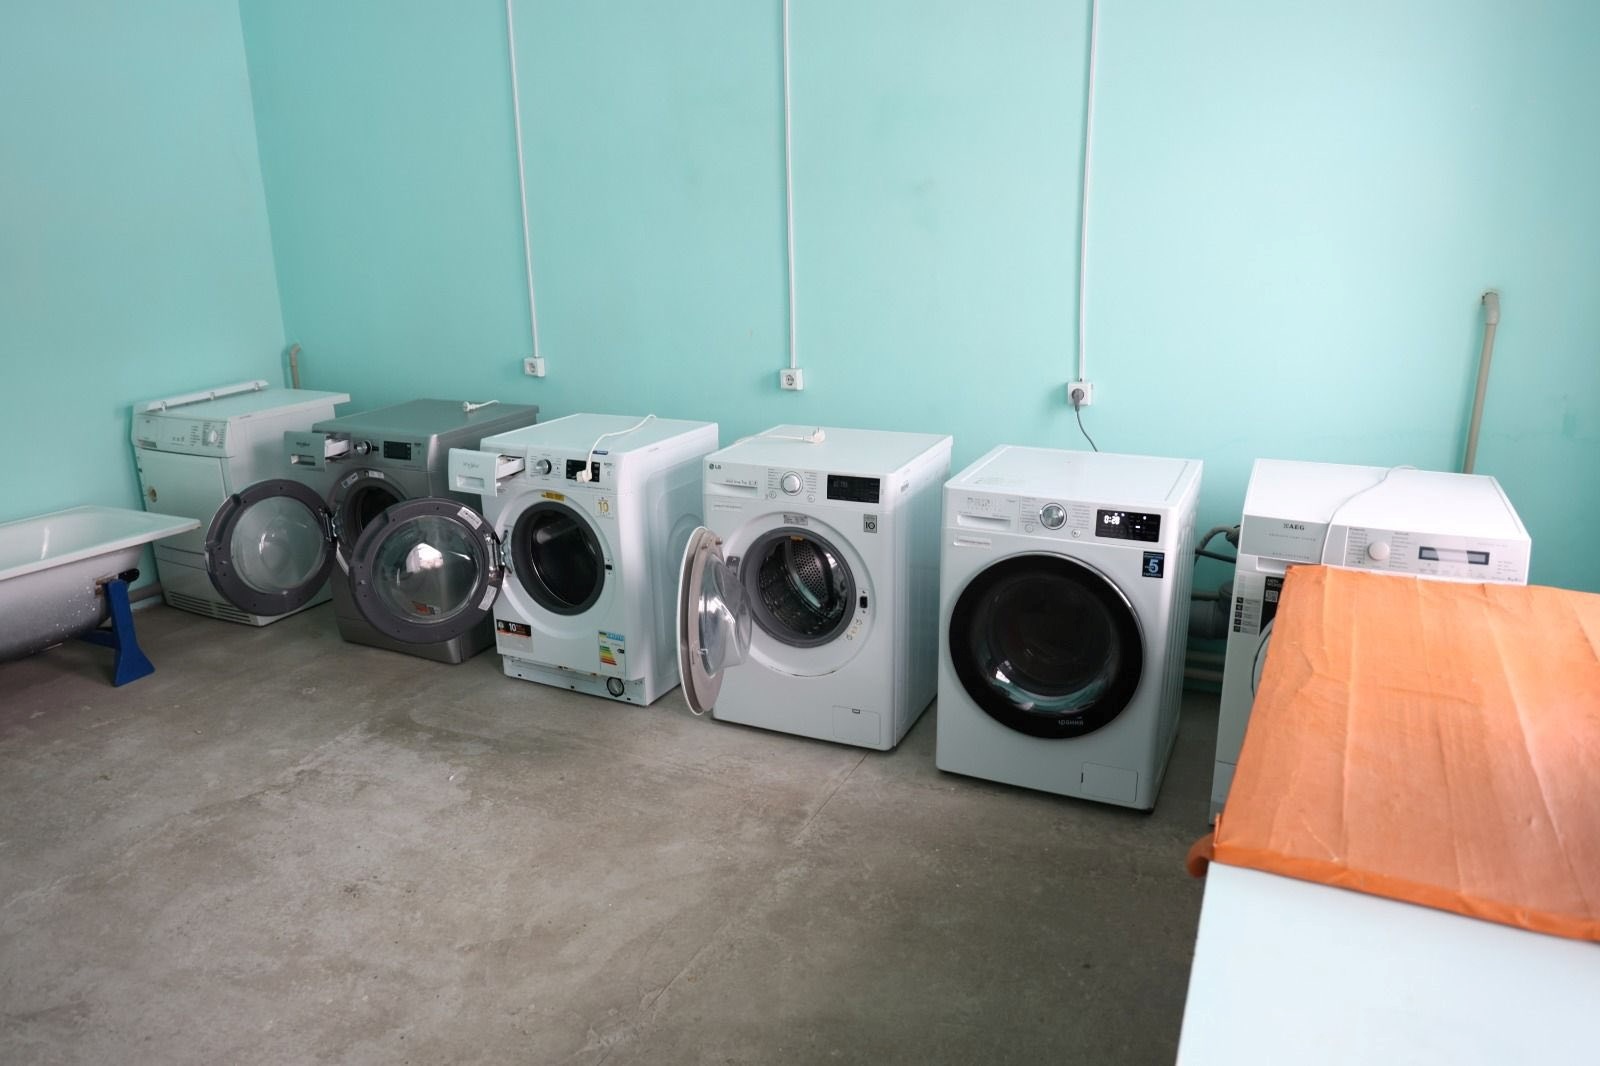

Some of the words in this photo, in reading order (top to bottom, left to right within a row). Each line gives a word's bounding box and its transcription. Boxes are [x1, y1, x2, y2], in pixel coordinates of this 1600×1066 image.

[598, 501, 609, 512] 10
[1288, 523, 1305, 531] AEG
[1148, 558, 1159, 574] 5
[509, 623, 517, 632] 10
